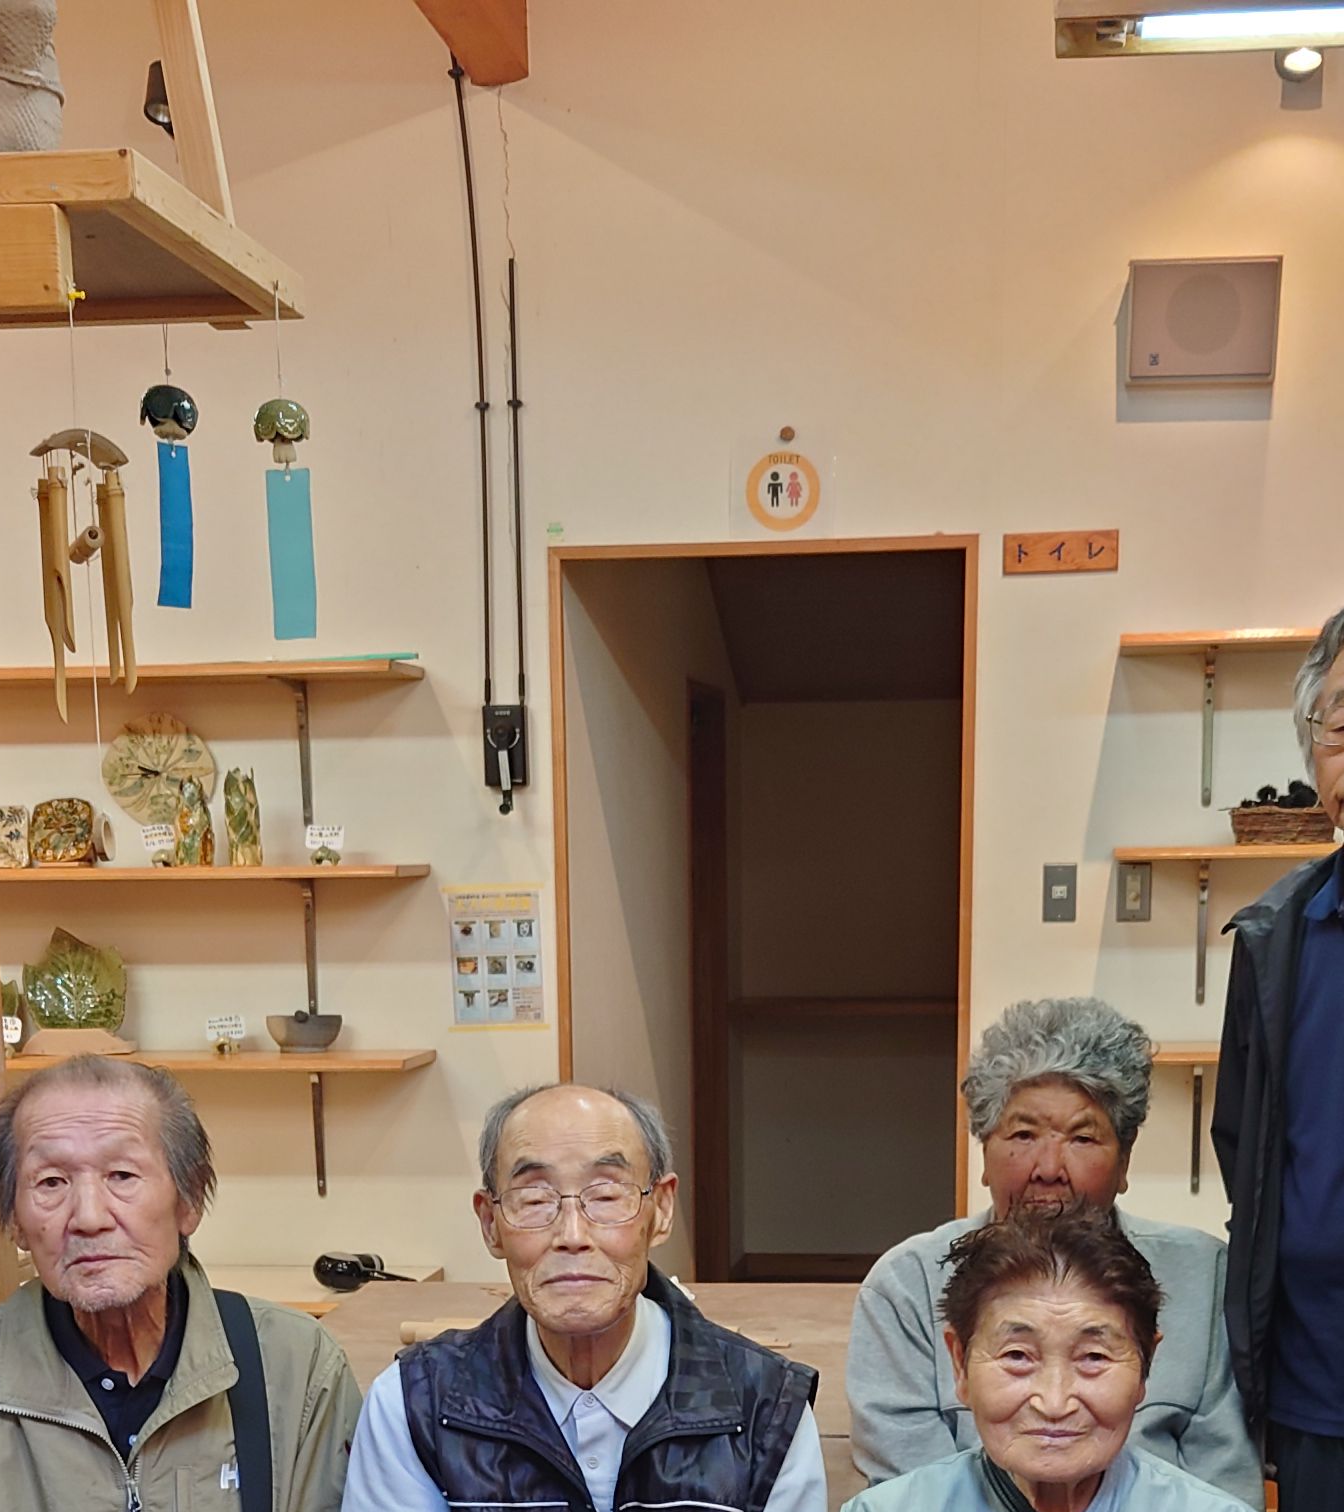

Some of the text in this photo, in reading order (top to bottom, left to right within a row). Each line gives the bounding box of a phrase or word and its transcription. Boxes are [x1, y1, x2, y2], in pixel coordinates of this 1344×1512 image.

[767, 454, 801, 465] TOILET
[1017, 541, 1105, 564] トイレ
